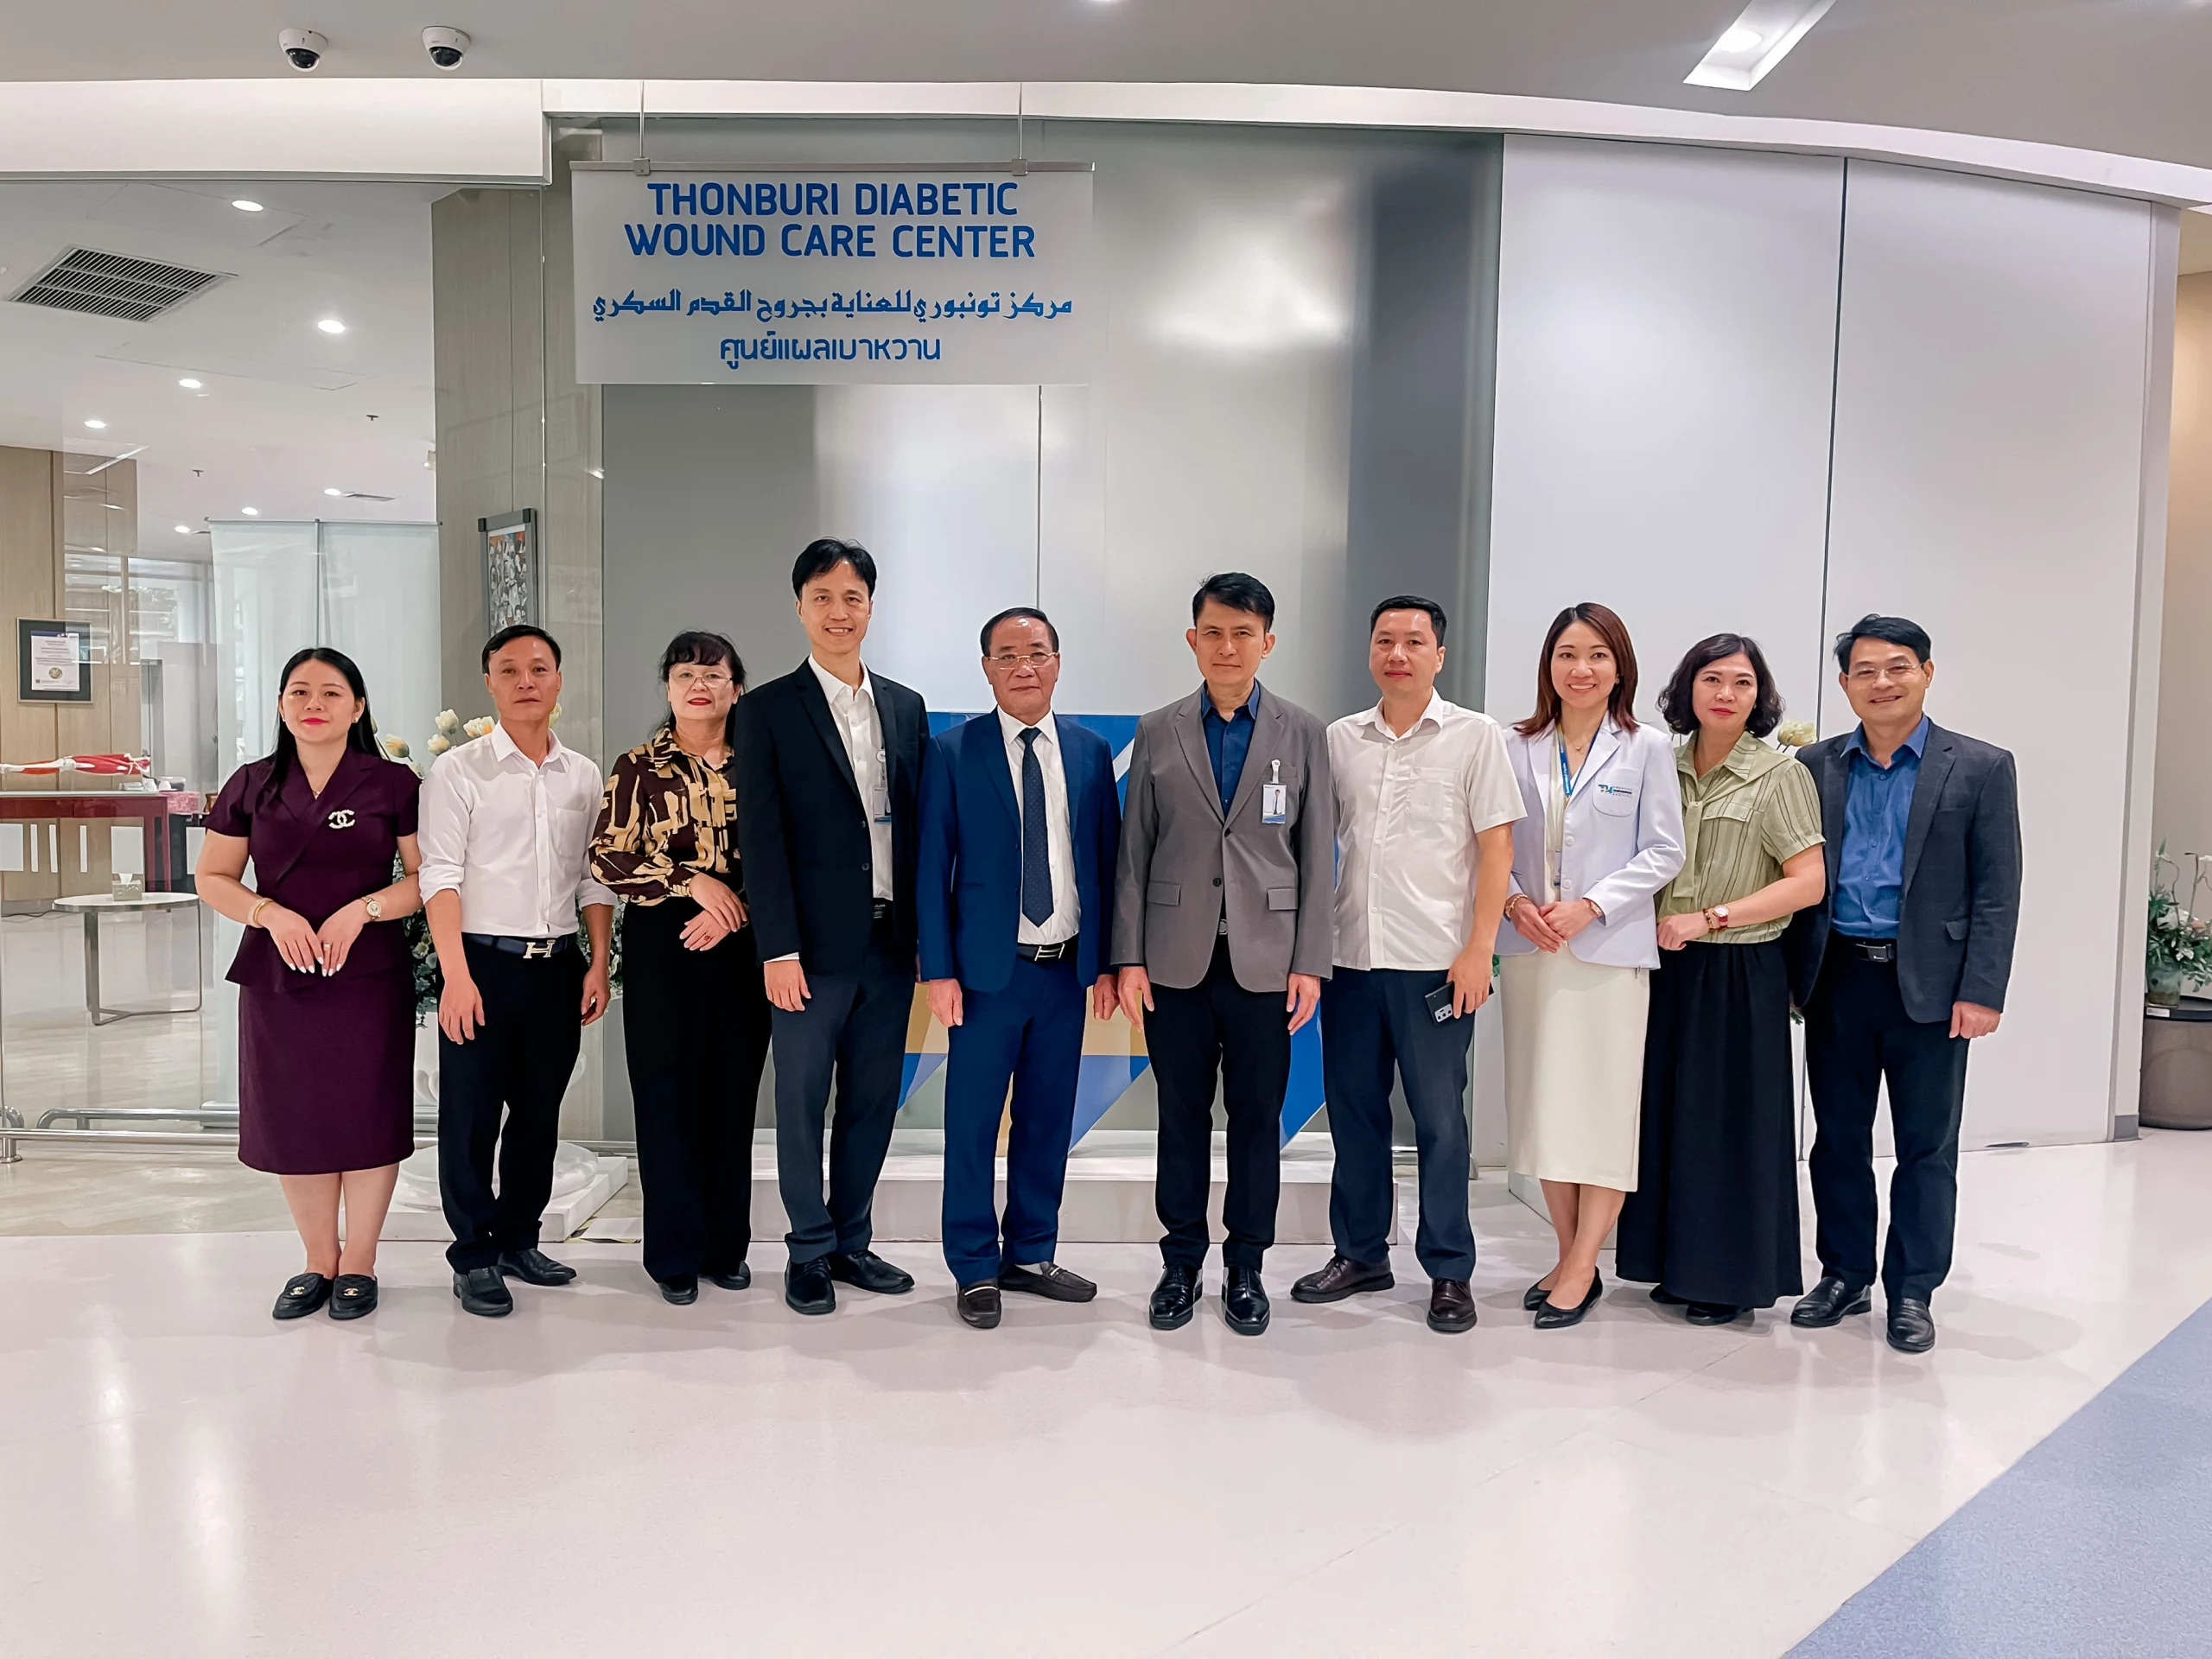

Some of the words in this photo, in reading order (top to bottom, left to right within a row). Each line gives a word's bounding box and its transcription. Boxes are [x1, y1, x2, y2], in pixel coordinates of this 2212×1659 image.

[647, 182, 839, 216] THONBURI
[855, 182, 1018, 216] DIABETIC
[624, 223, 766, 257] WOUND
[780, 223, 876, 257] CARE
[893, 224, 1035, 258] CENTER
[593, 289, 681, 322] السكري
[687, 289, 752, 316] القدم
[756, 298, 828, 322] بجروح
[830, 289, 912, 319] للعناية
[913, 291, 1001, 323] تونبوري
[1002, 290, 1072, 320] مركز
[720, 330, 941, 370] ศูนย์แผลเบาหวาน
